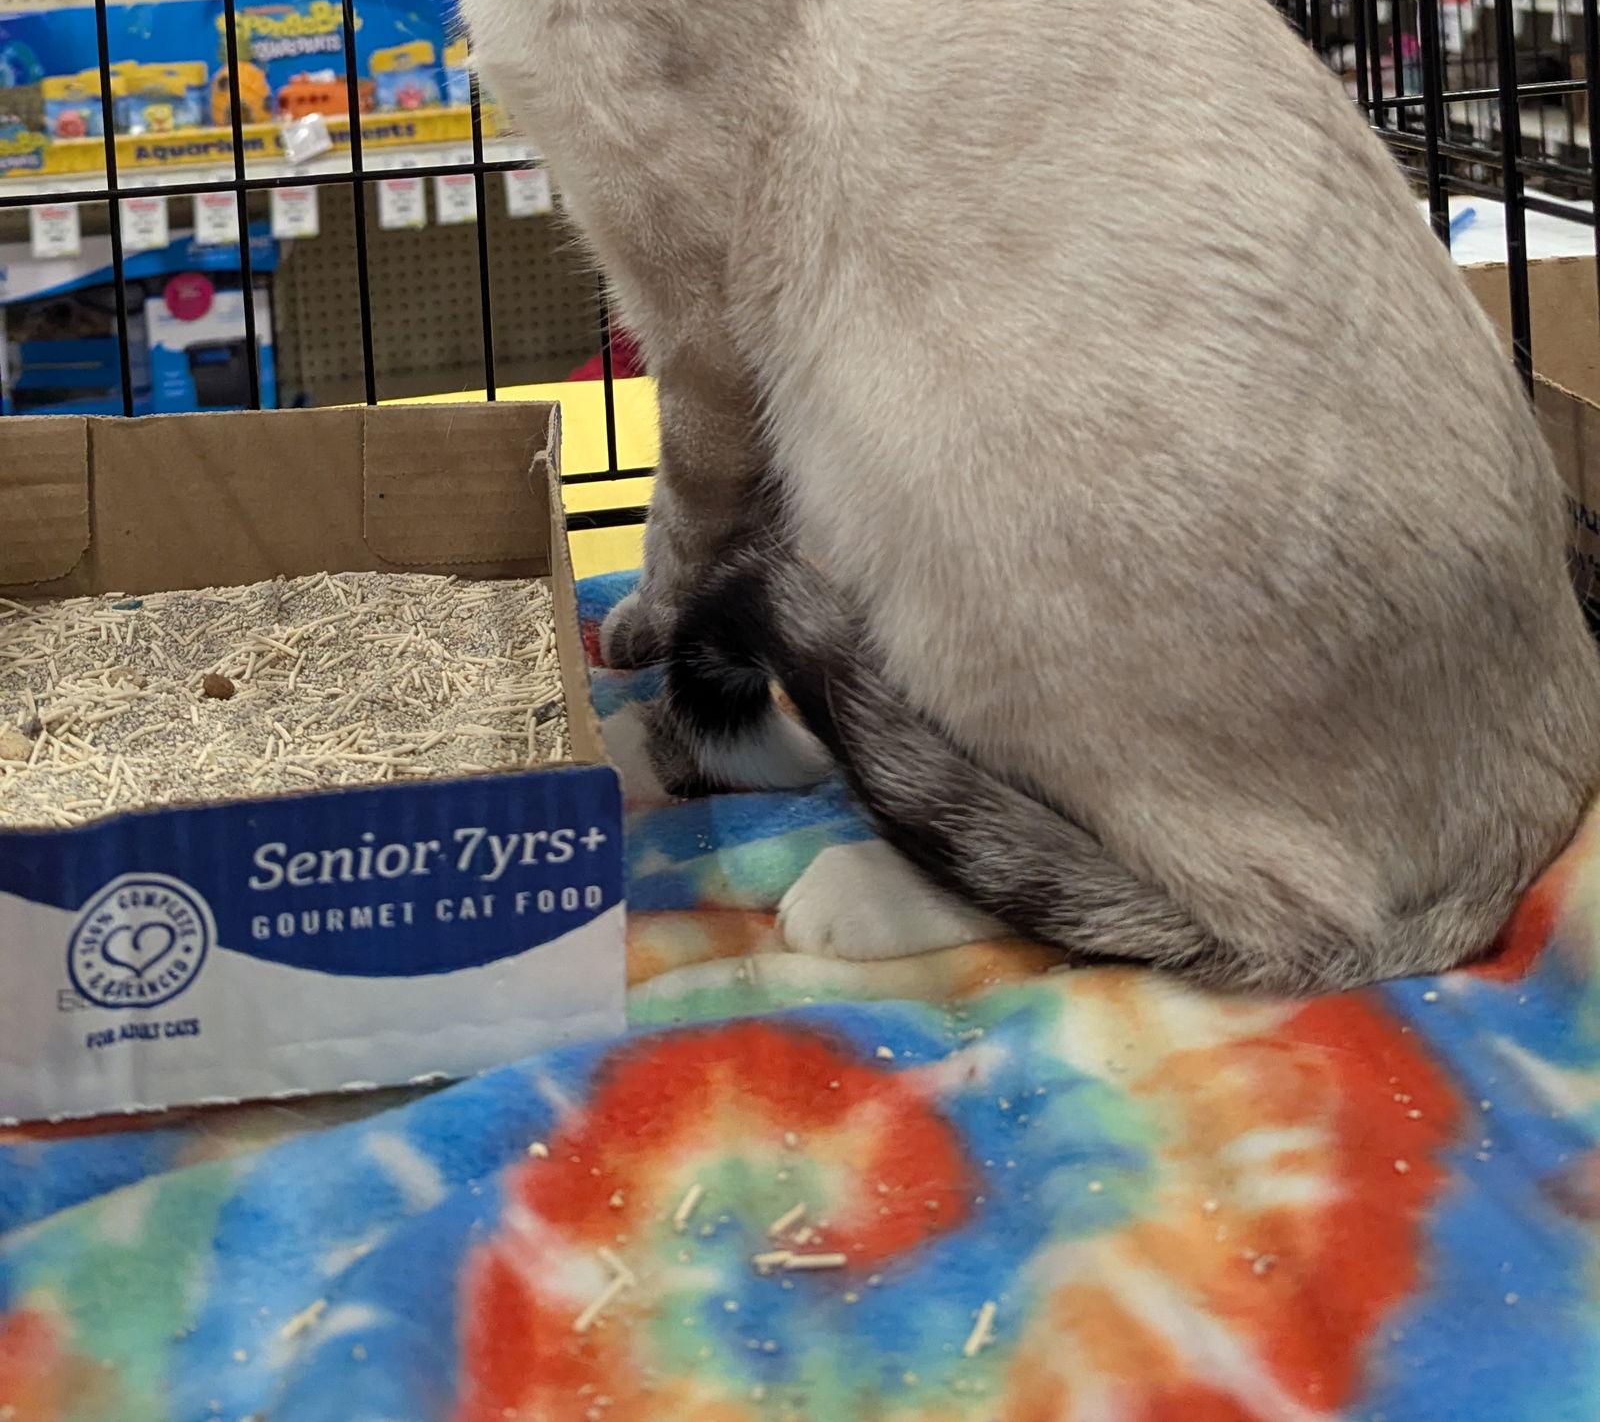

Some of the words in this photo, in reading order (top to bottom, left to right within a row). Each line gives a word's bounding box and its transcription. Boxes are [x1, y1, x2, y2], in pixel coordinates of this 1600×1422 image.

[248, 832, 441, 891] Senior
[453, 826, 608, 882] 7yrs+
[117, 890, 198, 937] COMPLETE
[251, 901, 416, 940] GOURMET
[435, 894, 497, 922] CAT
[515, 884, 603, 915] FOOD
[86, 1028, 115, 1049] FOR
[119, 1022, 160, 1040] ADULT
[164, 1018, 200, 1038] CATS
